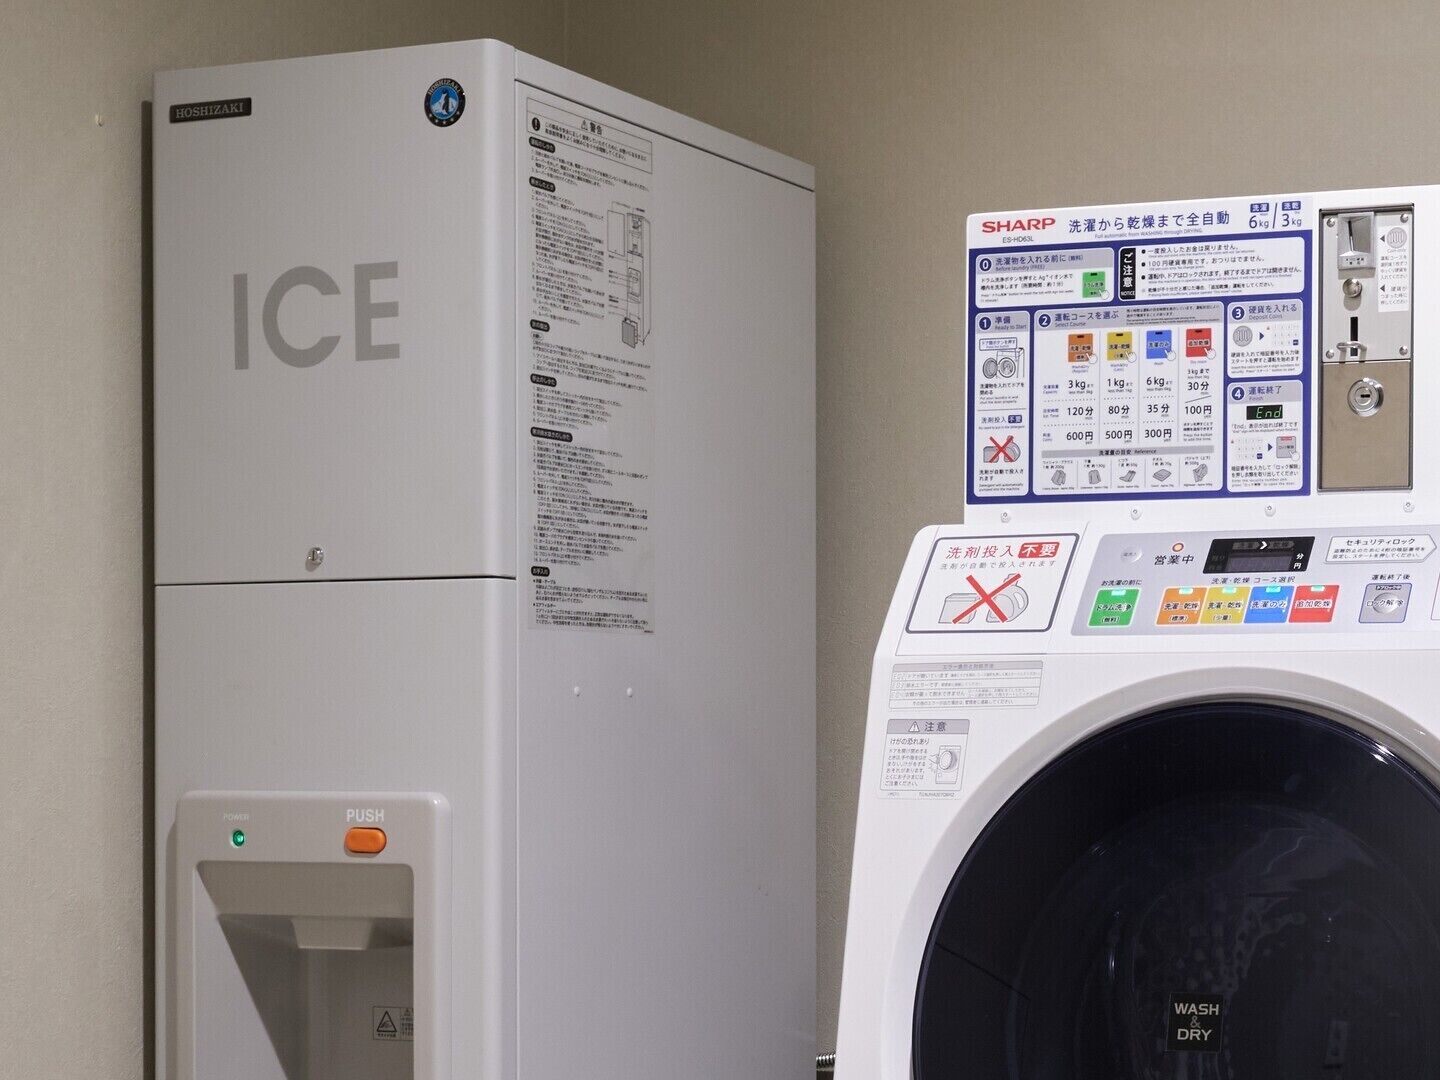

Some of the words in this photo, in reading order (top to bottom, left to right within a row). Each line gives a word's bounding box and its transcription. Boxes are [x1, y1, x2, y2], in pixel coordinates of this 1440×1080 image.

[175, 102, 245, 119] HOSHIZAKI
[981, 217, 1056, 233] SHARP
[1068, 210, 1230, 234] 洗濯から乾燥まで全自動
[1002, 235, 1034, 244] ES-HD63L
[995, 255, 1067, 266] 洗濯物を入れる前に
[1122, 252, 1134, 288] ご注意
[232, 260, 400, 371] ICE
[1248, 304, 1298, 314] 硬貨を入れる
[994, 316, 1011, 324] 準備
[1055, 310, 1120, 322] 運転コースを選ぶ
[1248, 385, 1282, 395] 運転終了
[1256, 406, 1282, 419] End
[1346, 538, 1416, 546] セキュリティロック
[945, 545, 1015, 560] 洗剤投入
[1021, 543, 1058, 557] 不要
[1154, 555, 1195, 566] 営業中
[1293, 562, 1302, 570] 円
[1371, 573, 1411, 581] 運転終了後
[346, 808, 385, 823] PUSH
[1174, 1002, 1220, 1016] WASH
[1190, 1015, 1200, 1029] &
[1177, 1028, 1213, 1041] DRY
